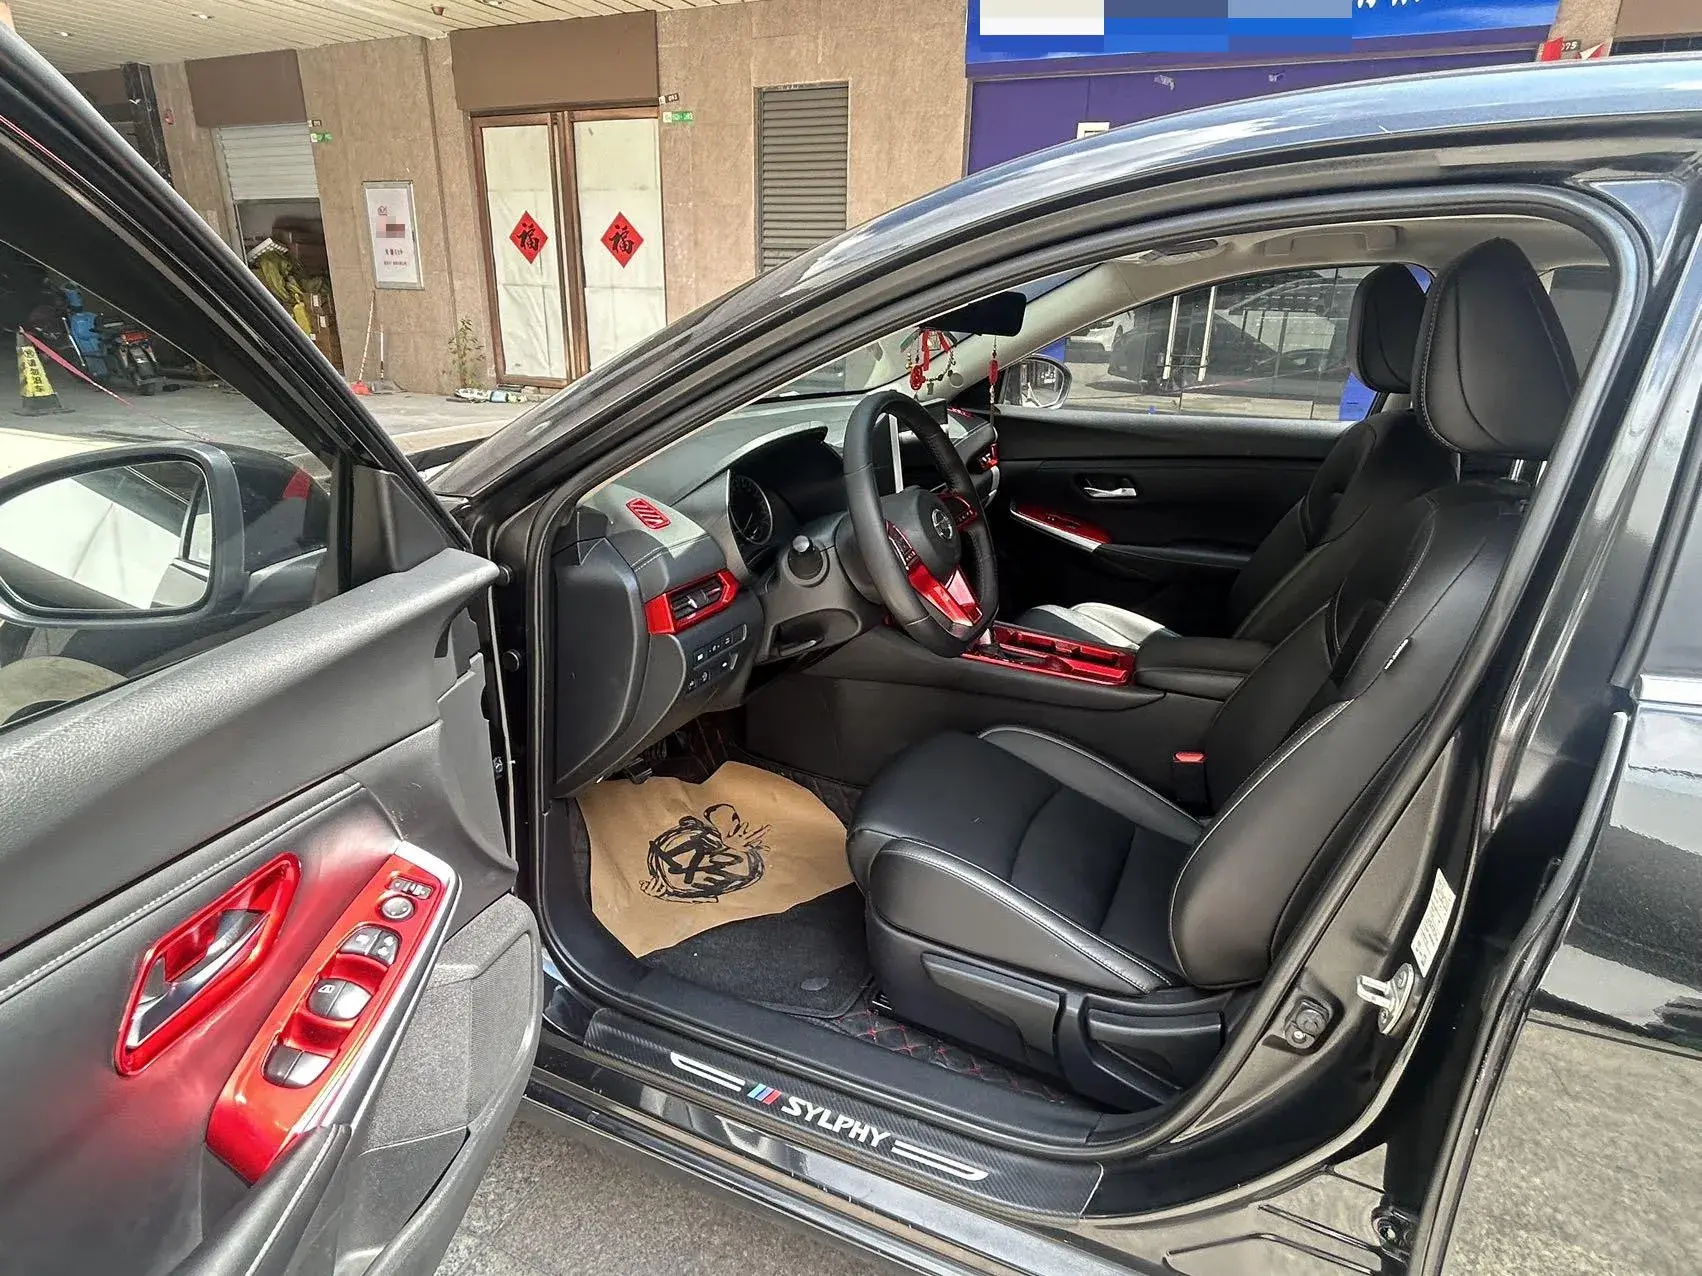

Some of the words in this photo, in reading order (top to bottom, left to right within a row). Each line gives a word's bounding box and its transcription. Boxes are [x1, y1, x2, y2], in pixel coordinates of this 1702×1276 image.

[517, 222, 540, 252] 福
[609, 223, 634, 255] 福
[780, 1095, 892, 1148] SYLPHY
